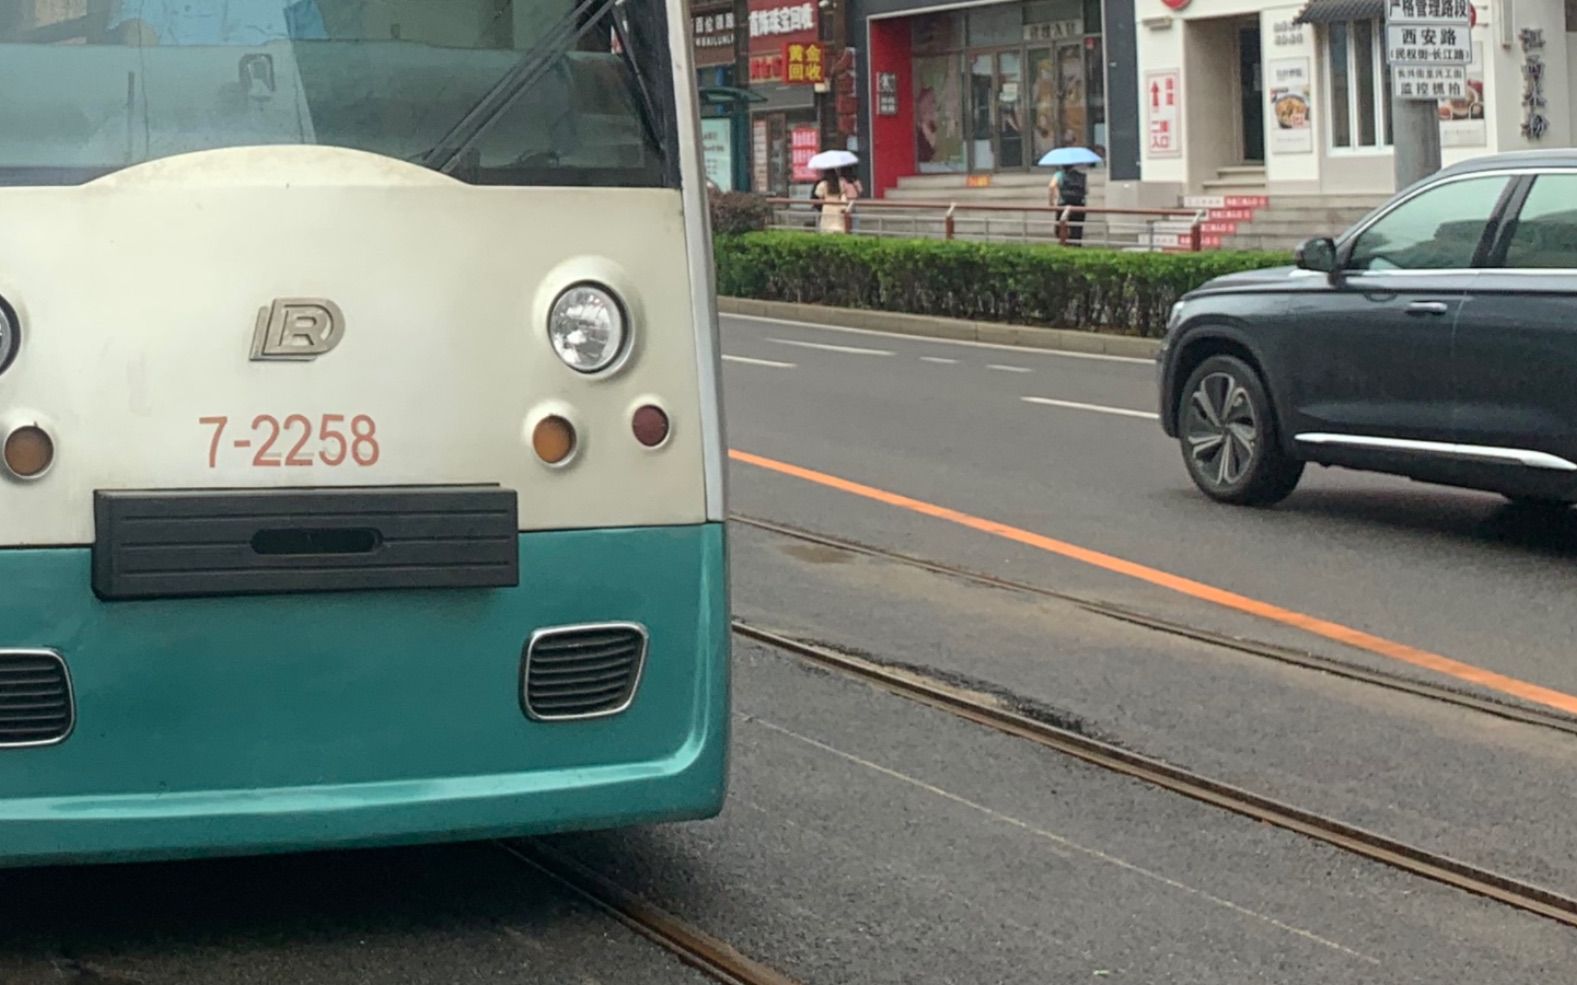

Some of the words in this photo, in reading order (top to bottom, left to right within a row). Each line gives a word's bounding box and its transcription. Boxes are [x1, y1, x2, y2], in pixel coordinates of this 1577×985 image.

[1401, 27, 1457, 46] 西安路
[788, 43, 822, 63] 黄金
[788, 62, 822, 81] 回收
[198, 414, 380, 469] 7-2258
